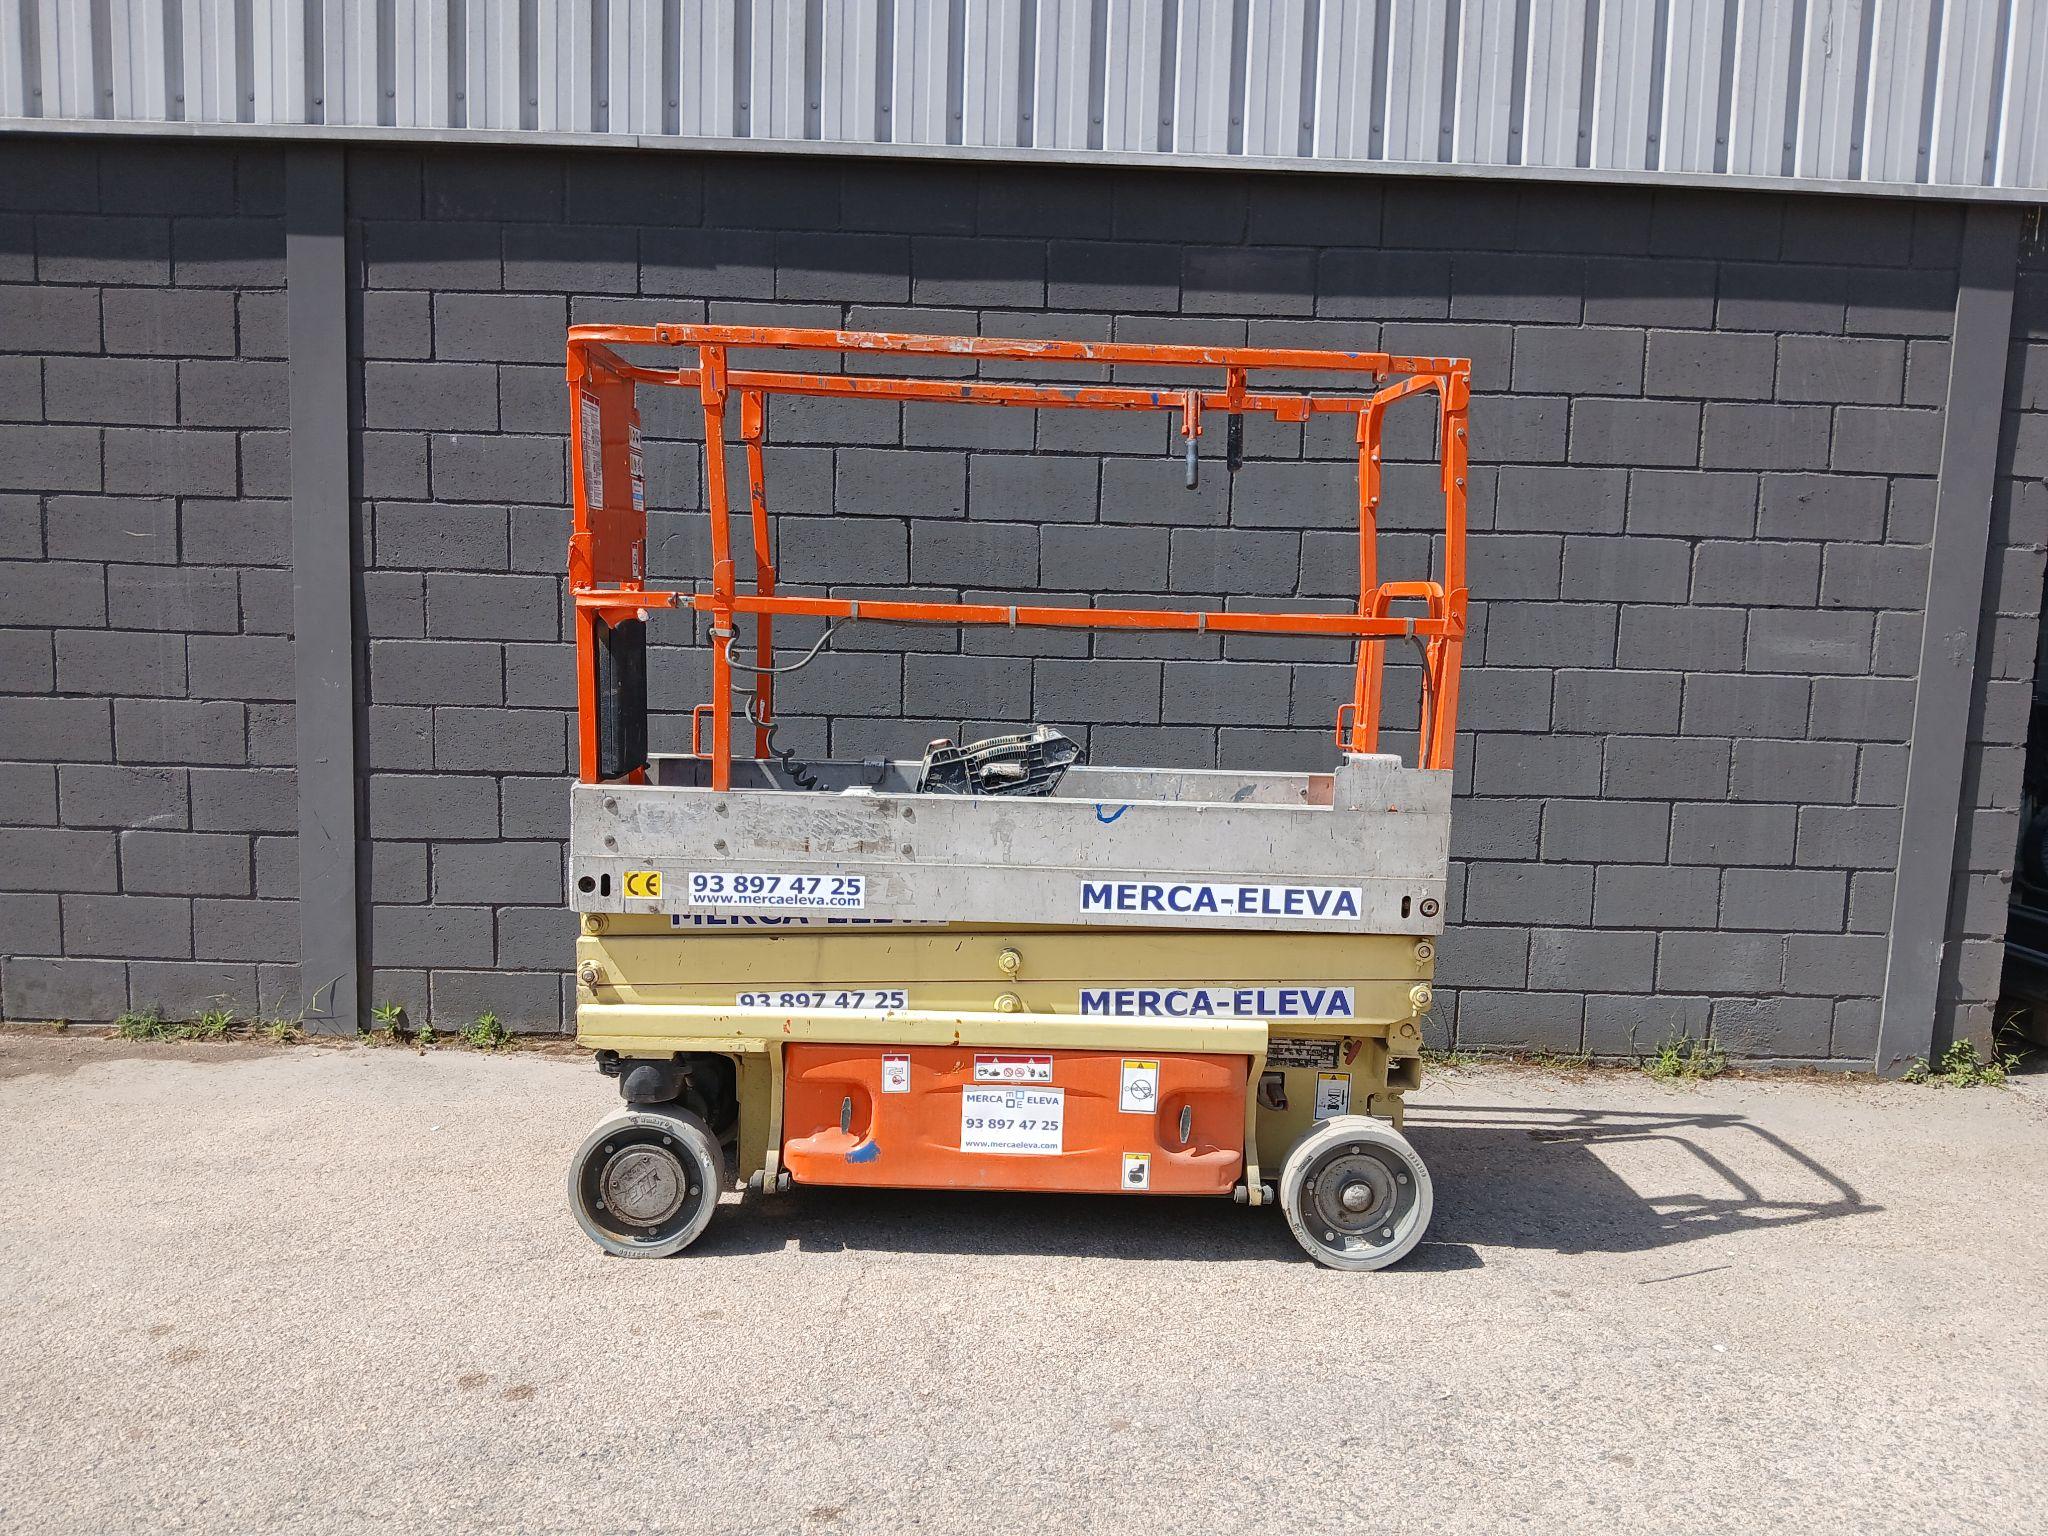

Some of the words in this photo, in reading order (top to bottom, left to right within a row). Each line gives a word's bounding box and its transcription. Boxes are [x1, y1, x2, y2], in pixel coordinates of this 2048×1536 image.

[693, 875, 724, 893] 93
[733, 875, 782, 894] 897
[789, 877, 822, 895] 47
[830, 878, 861, 896] 25
[693, 893, 861, 906] www.mercaeleva.com
[1082, 884, 1357, 916] MERCA-ELEVA
[740, 993, 771, 1007] 93
[779, 992, 827, 1008] 897
[834, 992, 866, 1009] 47
[874, 991, 904, 1009] 25
[1081, 989, 1352, 1016] MERCA-ELEVA
[966, 1095, 1003, 1103] MERCA
[1027, 1096, 1059, 1105] ELEVA
[966, 1118, 984, 1129] 93
[988, 1119, 1015, 1129] 897
[1019, 1120, 1037, 1130] 47
[1041, 1121, 1059, 1131] 25
[965, 1141, 1058, 1149] www.mercaeleva.com
